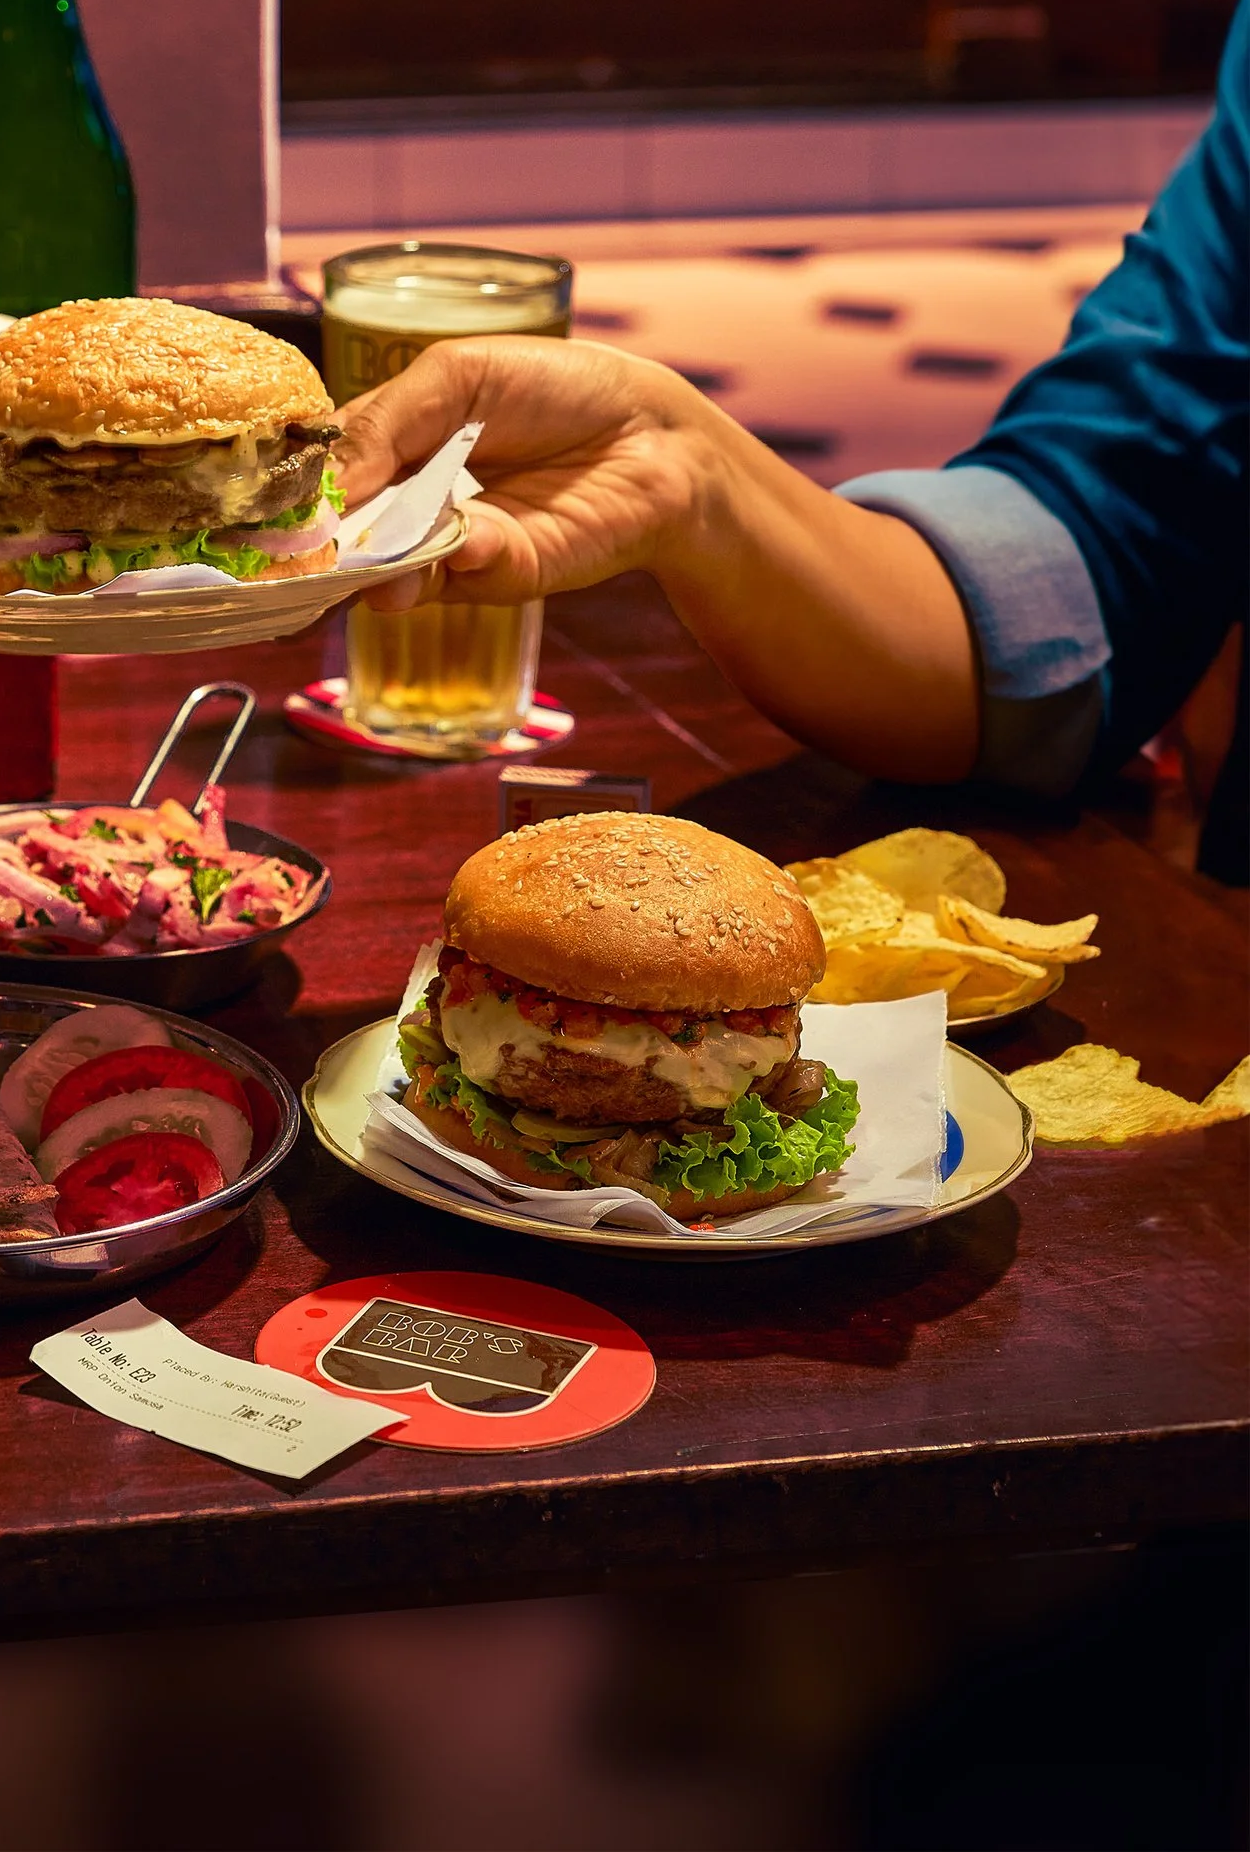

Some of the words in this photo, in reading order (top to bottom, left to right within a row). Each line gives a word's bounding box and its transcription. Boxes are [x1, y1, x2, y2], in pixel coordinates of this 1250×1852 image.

[362, 1329, 469, 1364] BAR
[377, 1311, 524, 1355] BOB'S
[80, 1328, 113, 1355] Table
[108, 1353, 130, 1370] No:
[128, 1366, 157, 1384] E23
[162, 1358, 201, 1378] Placed
[77, 1357, 99, 1372] MRP
[98, 1372, 127, 1395] Onion
[230, 1404, 264, 1422] Time:
